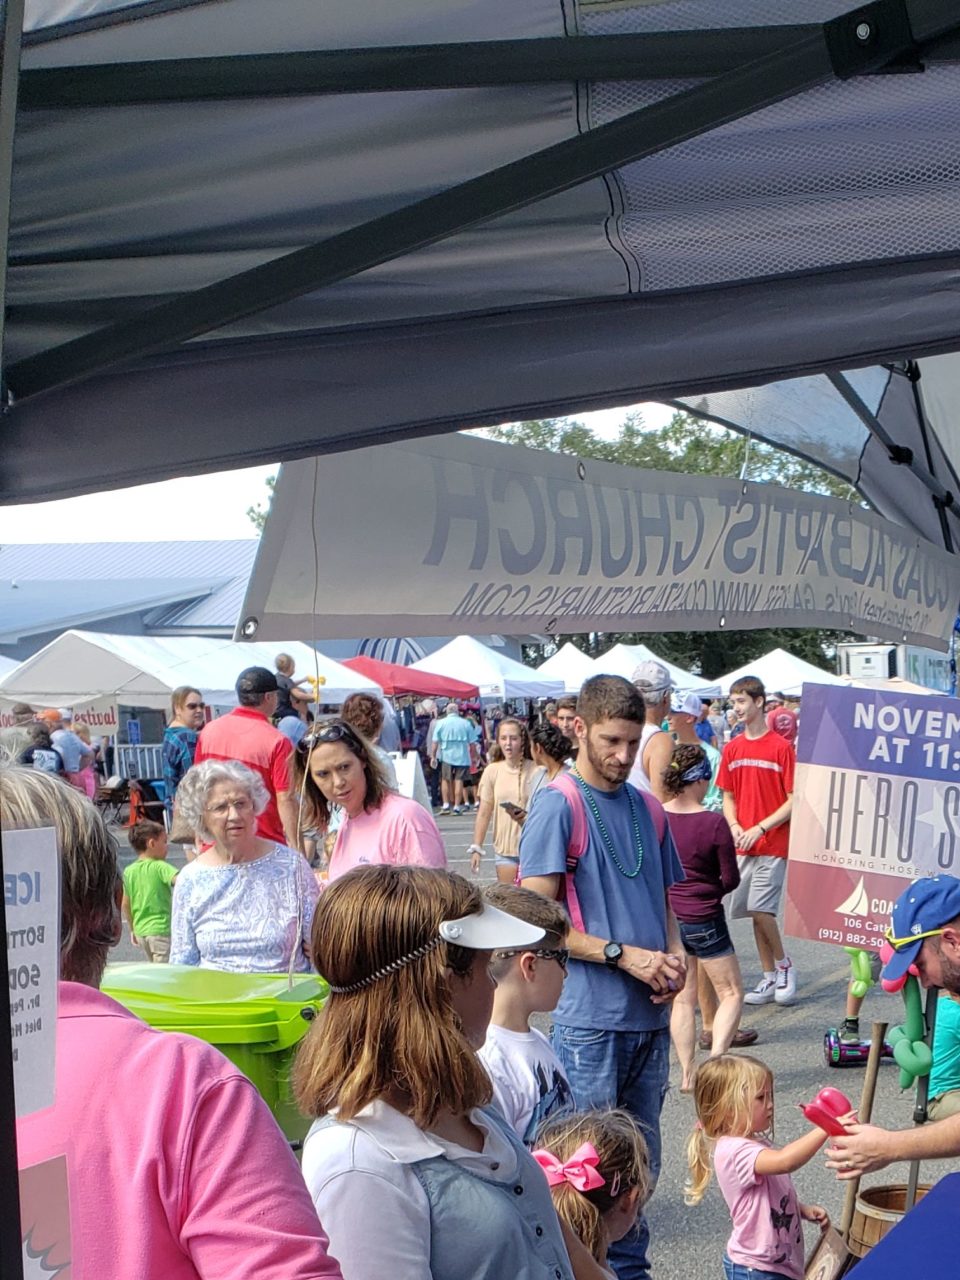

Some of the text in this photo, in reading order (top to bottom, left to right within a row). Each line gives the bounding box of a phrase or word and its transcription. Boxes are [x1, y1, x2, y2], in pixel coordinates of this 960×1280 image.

[73, 706, 117, 726] estival
[868, 735, 910, 764] AT
[825, 770, 919, 863] HERO
[813, 854, 875, 869] HONORING
[881, 863, 920, 876] THOSE
[871, 898, 894, 915] COA
[844, 917, 862, 929] 106
[818, 927, 884, 948] (912) 882-50
